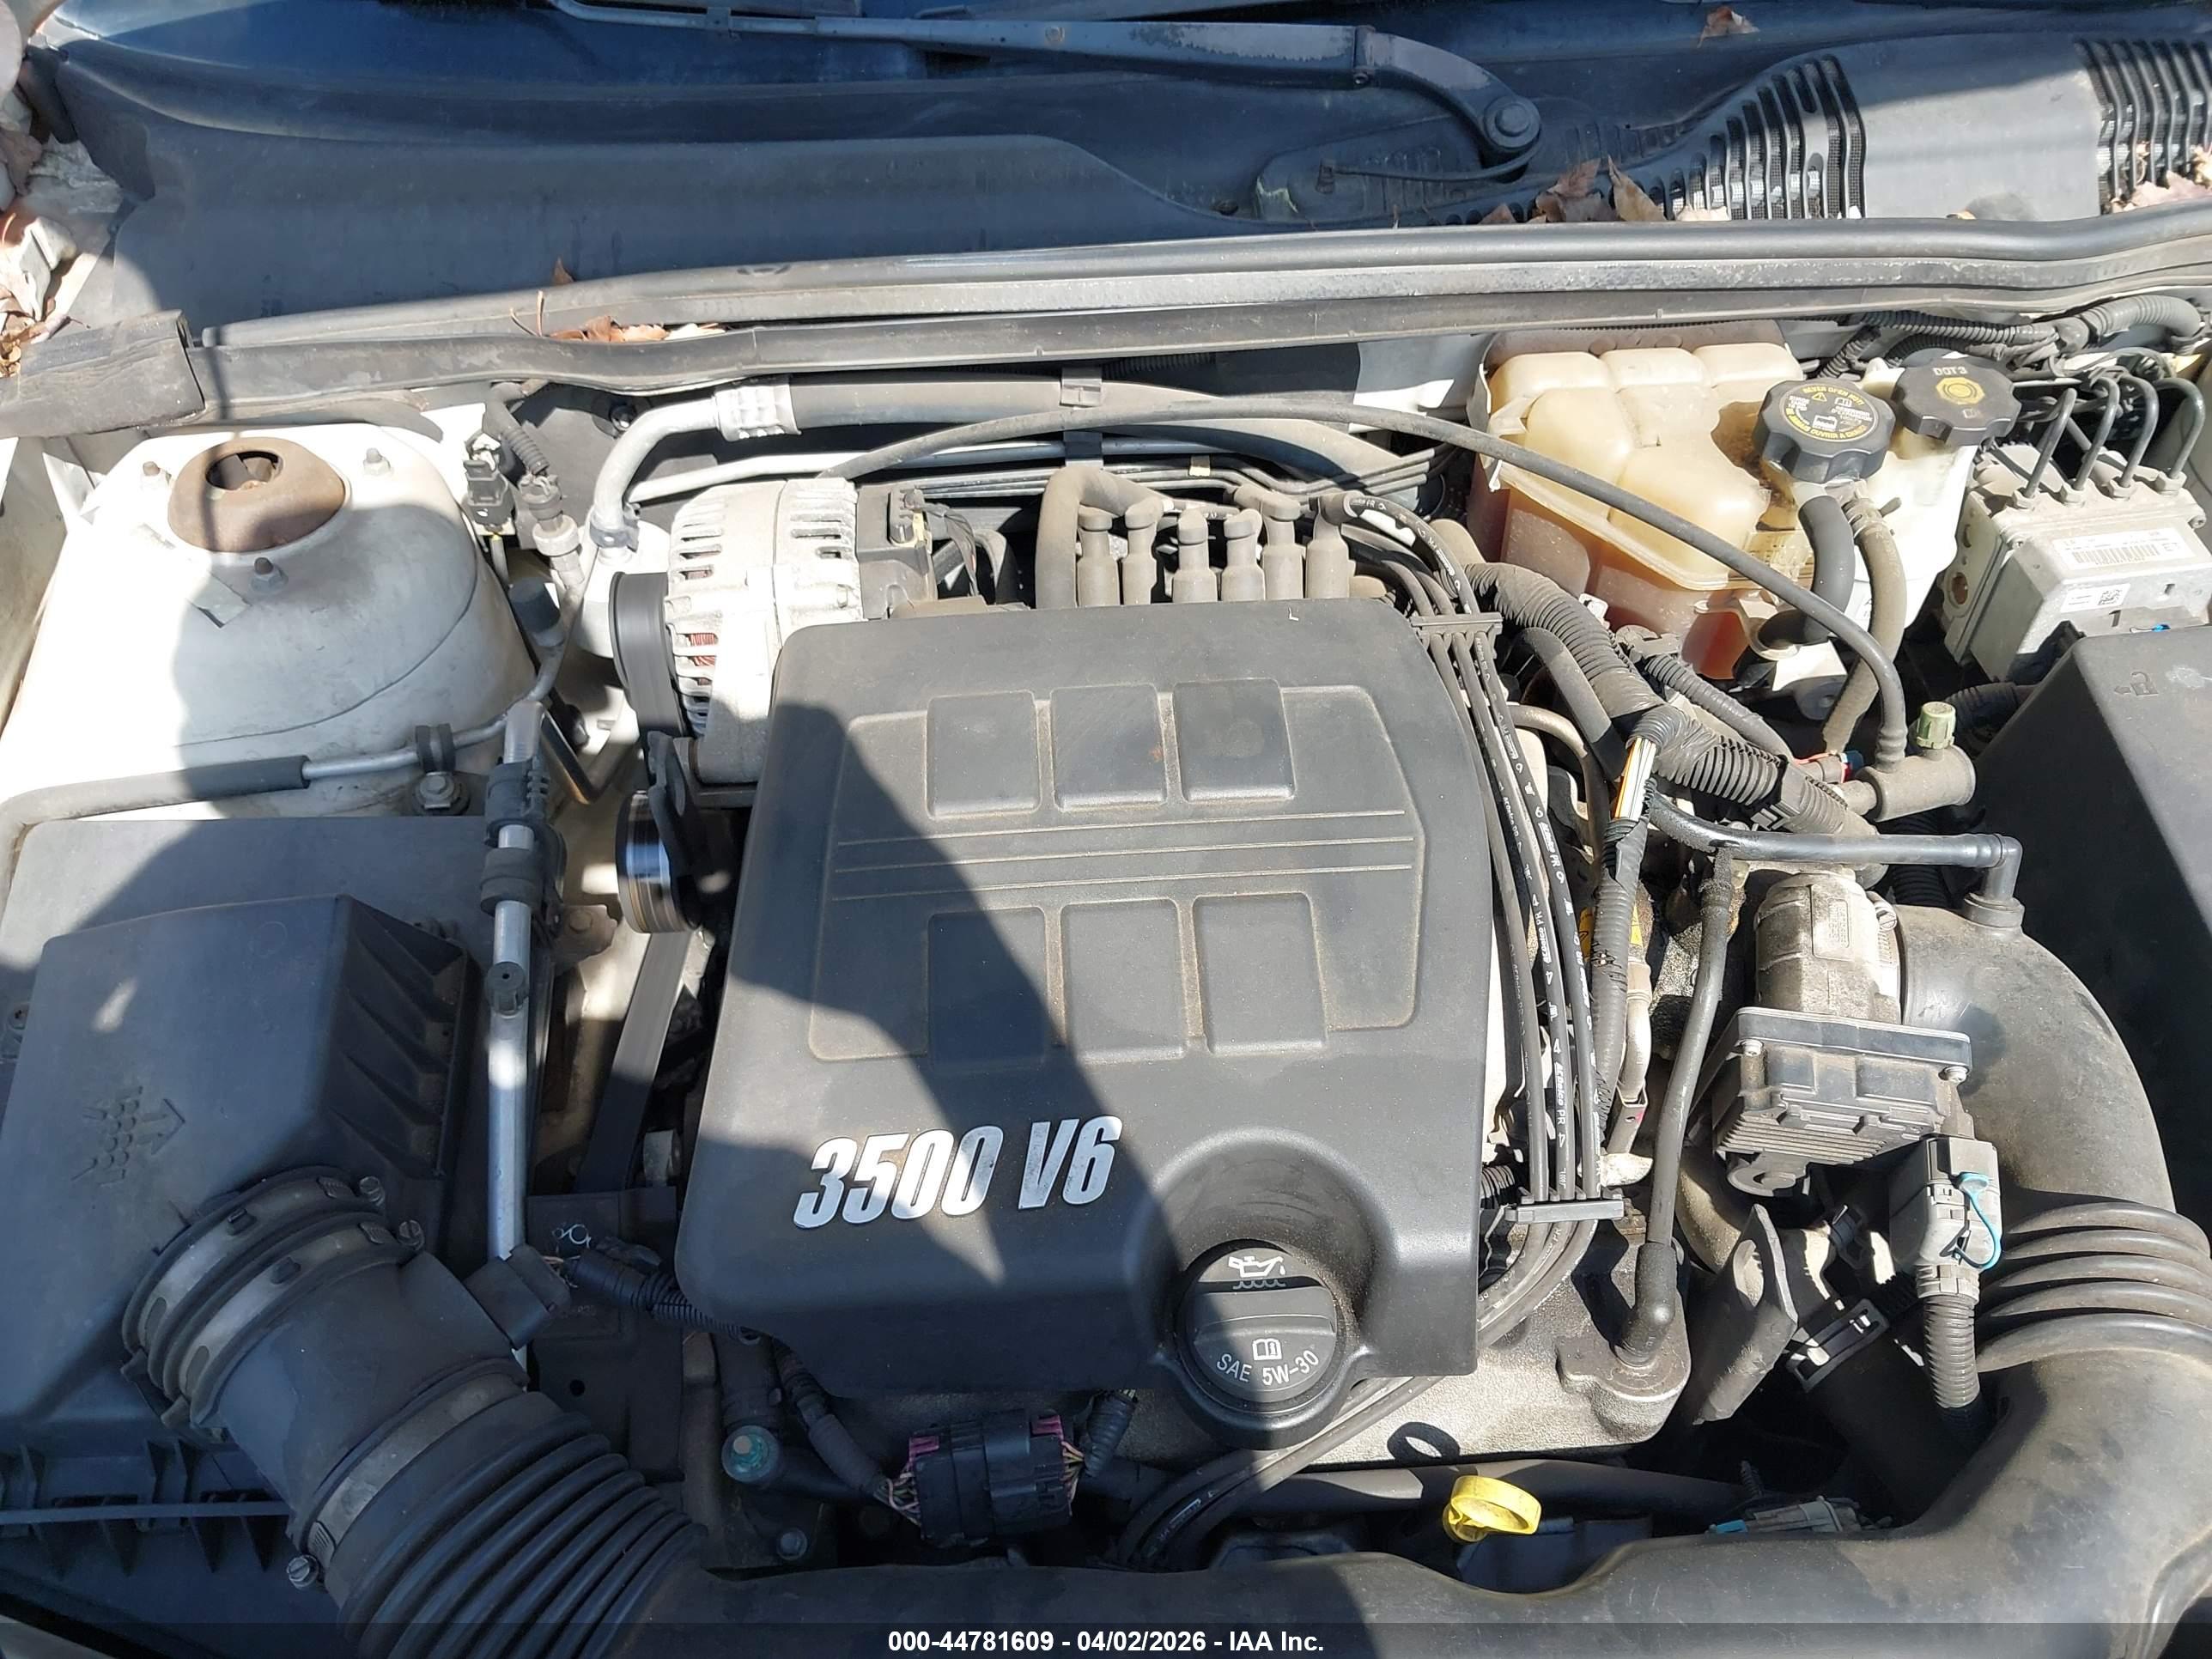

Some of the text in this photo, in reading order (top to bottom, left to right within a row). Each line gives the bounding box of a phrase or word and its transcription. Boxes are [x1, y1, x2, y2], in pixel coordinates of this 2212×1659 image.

[1557, 1109, 1566, 1126] PR
[793, 1115, 1123, 1229] 3500 V6
[1217, 1350, 1320, 1386] SAE 5W-30
